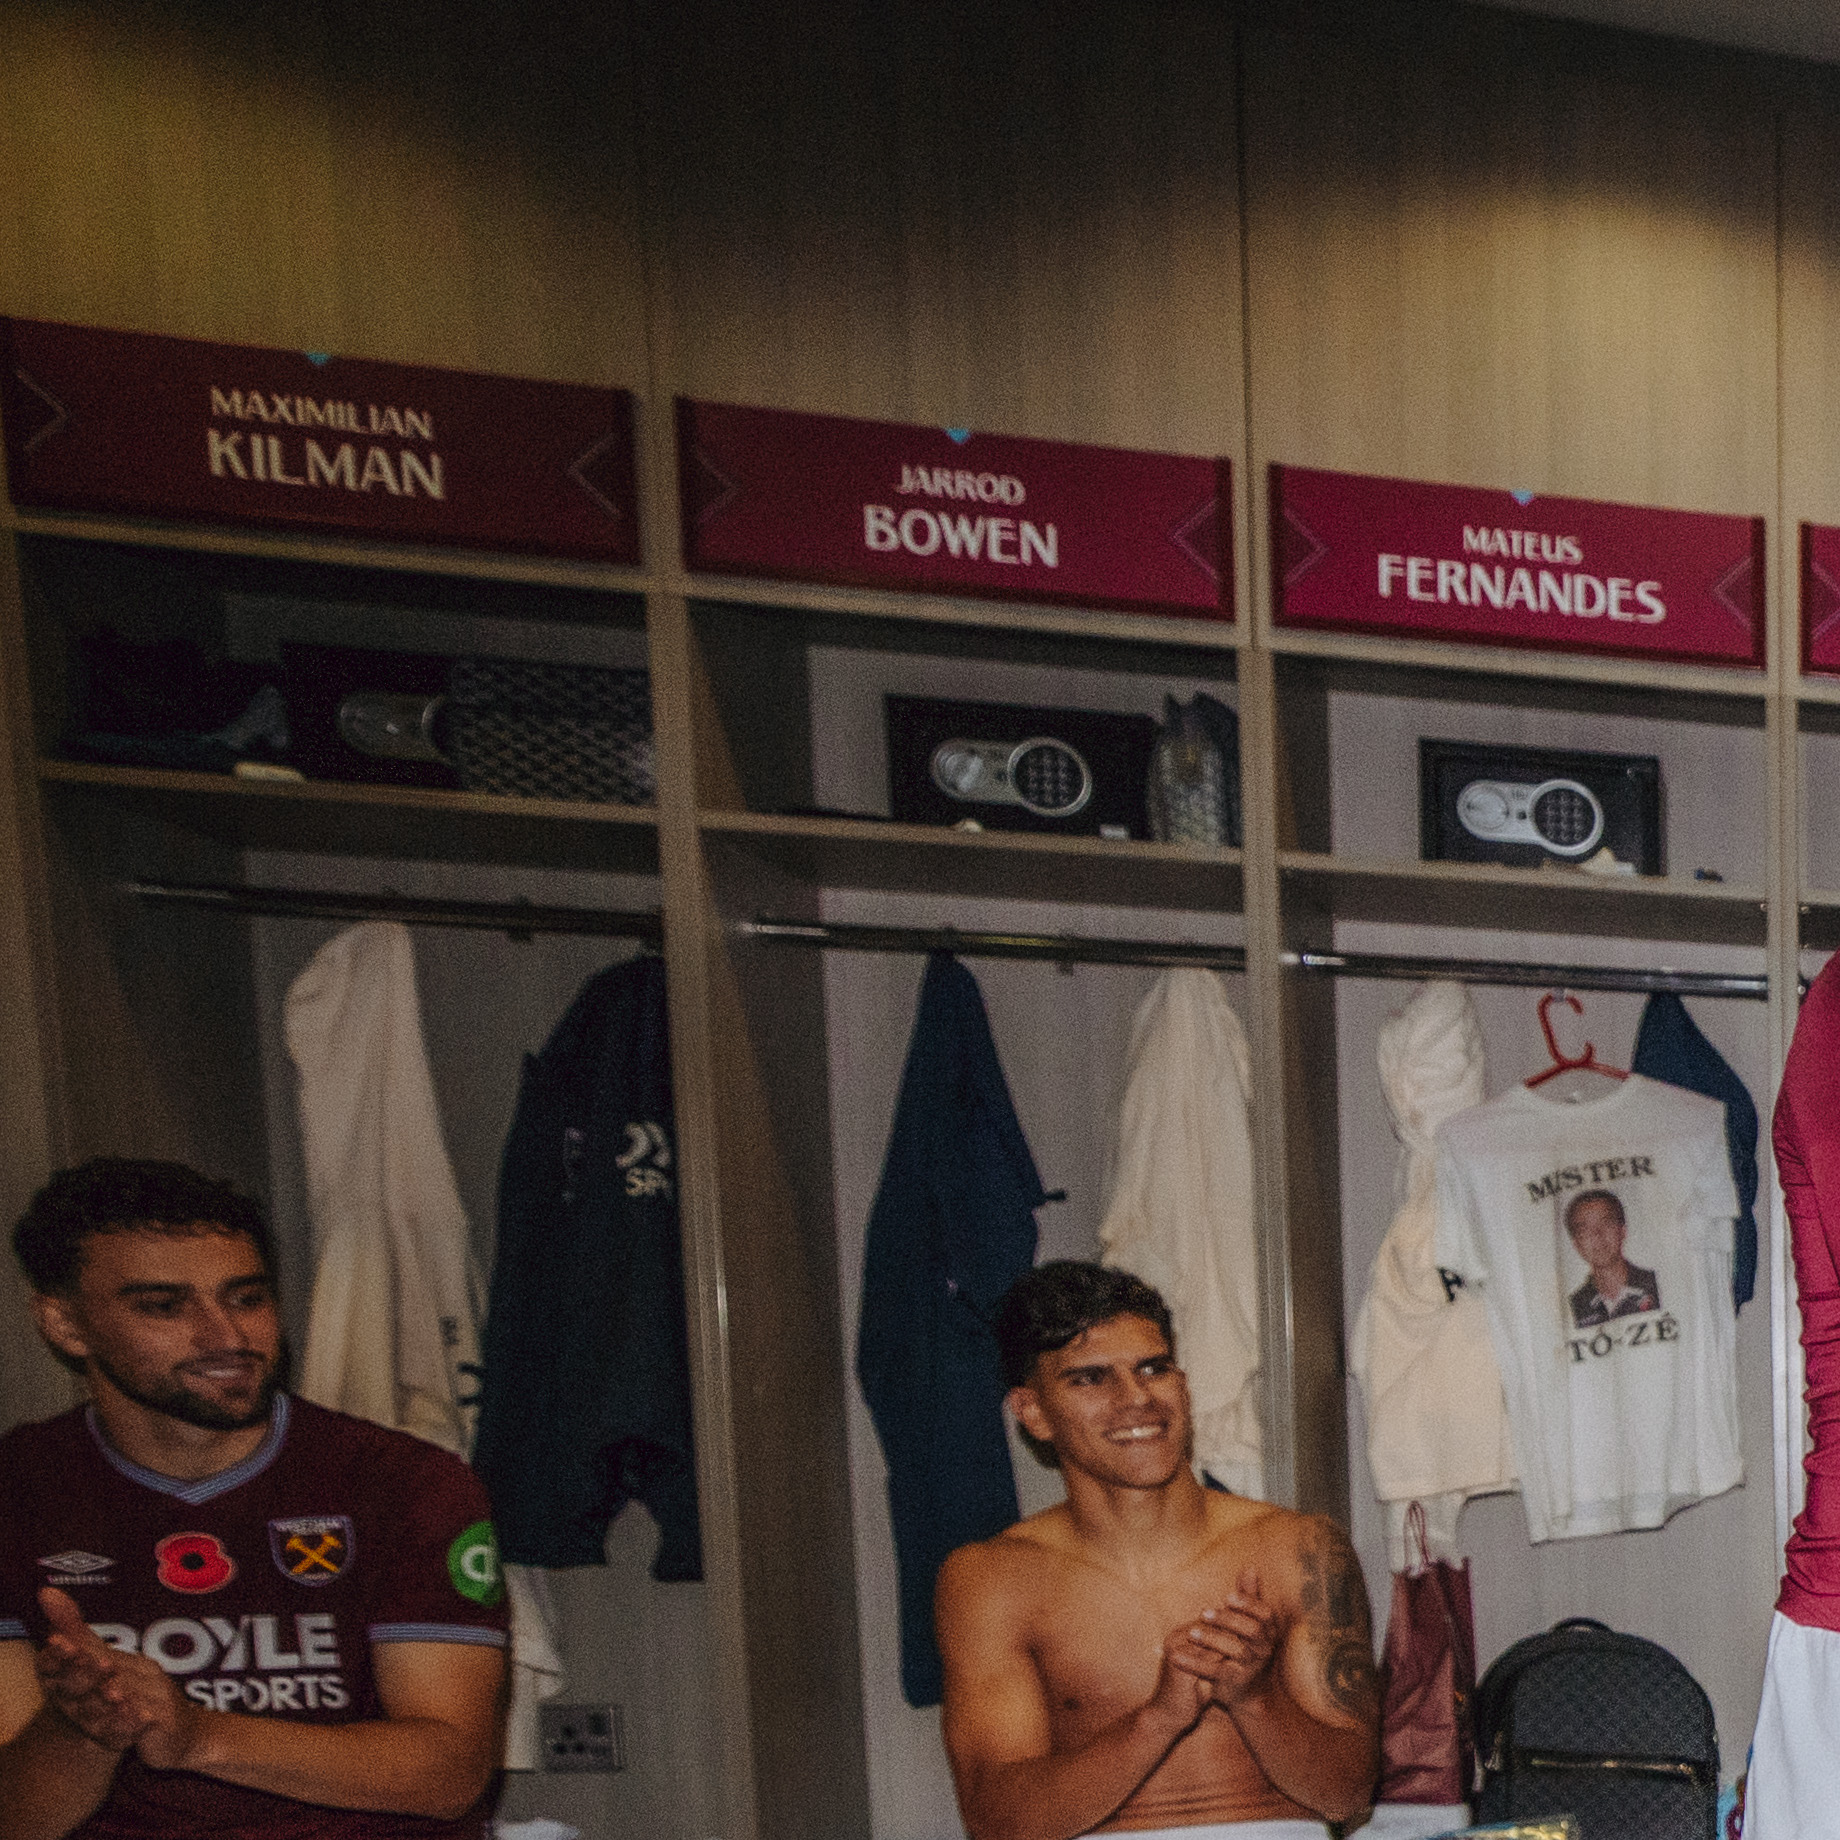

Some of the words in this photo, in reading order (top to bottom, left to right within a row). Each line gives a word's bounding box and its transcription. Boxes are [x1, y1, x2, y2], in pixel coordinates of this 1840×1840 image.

[210, 387, 434, 440] MAXIMILIAN
[206, 430, 447, 500] KILMAN
[896, 466, 1026, 506] JARROD
[863, 505, 1060, 568] BOWEN
[1462, 526, 1583, 565] MATEUS
[1376, 553, 1667, 625] FERNANDES
[1524, 1155, 1655, 1205] MISTER
[185, 1674, 350, 1713] SPORTS
